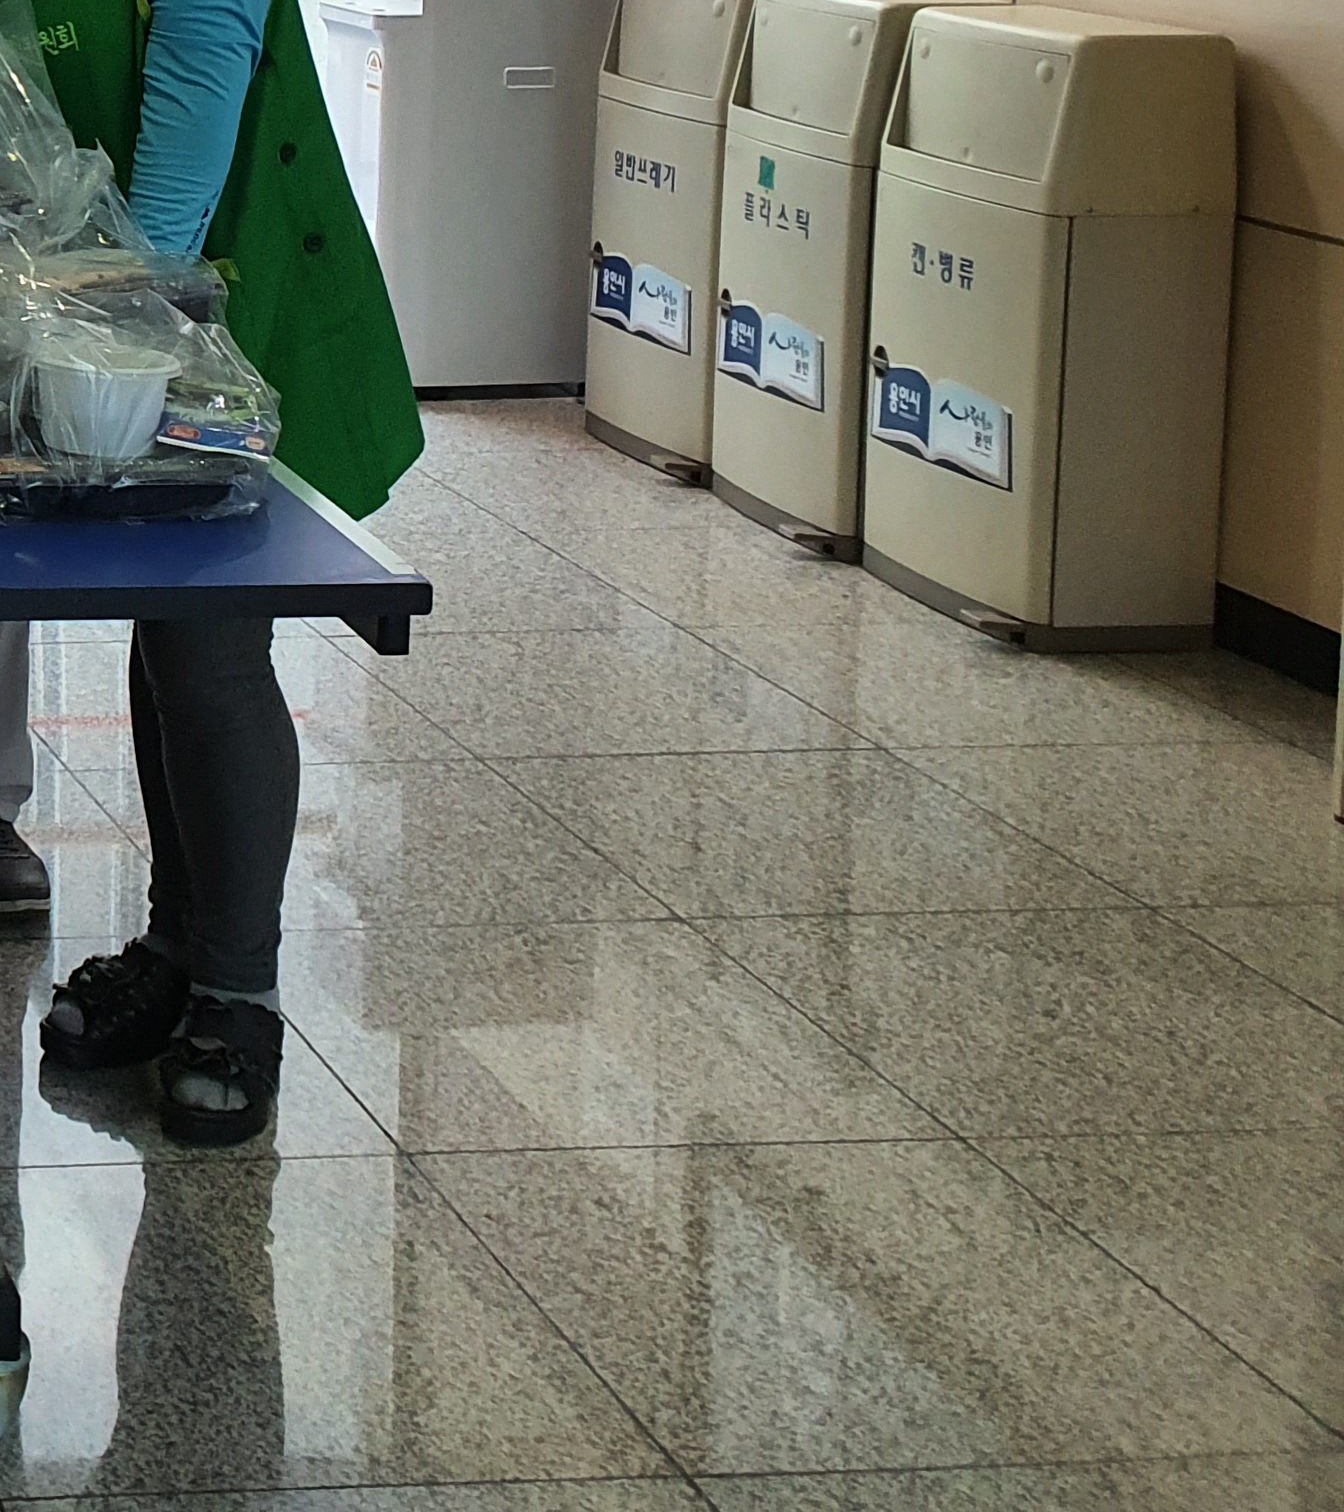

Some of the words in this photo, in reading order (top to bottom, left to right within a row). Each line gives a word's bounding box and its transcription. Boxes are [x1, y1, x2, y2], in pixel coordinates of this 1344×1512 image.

[37, 20, 80, 56] 원회
[614, 149, 676, 193] 일반쓰레기
[744, 191, 811, 240] 플라스틱
[602, 268, 626, 296] 용인시
[730, 318, 756, 348] 용인시
[888, 382, 922, 415] 용인시
